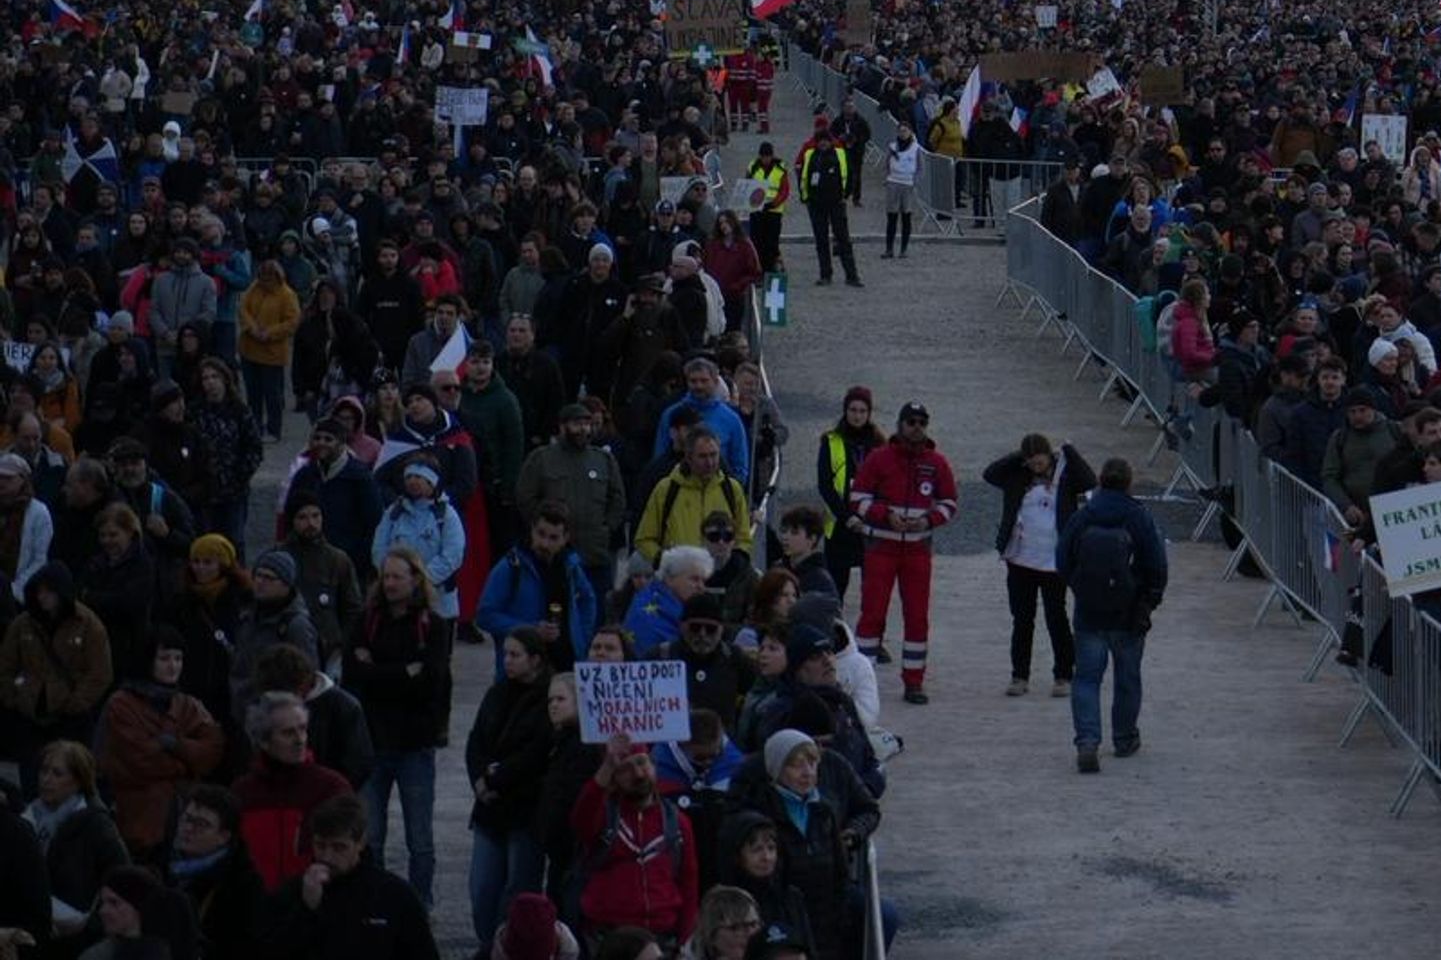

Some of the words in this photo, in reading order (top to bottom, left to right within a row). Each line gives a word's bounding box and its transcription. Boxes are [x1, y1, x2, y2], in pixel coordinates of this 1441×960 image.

[610, 664, 648, 682] BYLO
[651, 662, 682, 679] DOST
[597, 714, 664, 734] HRANIC
